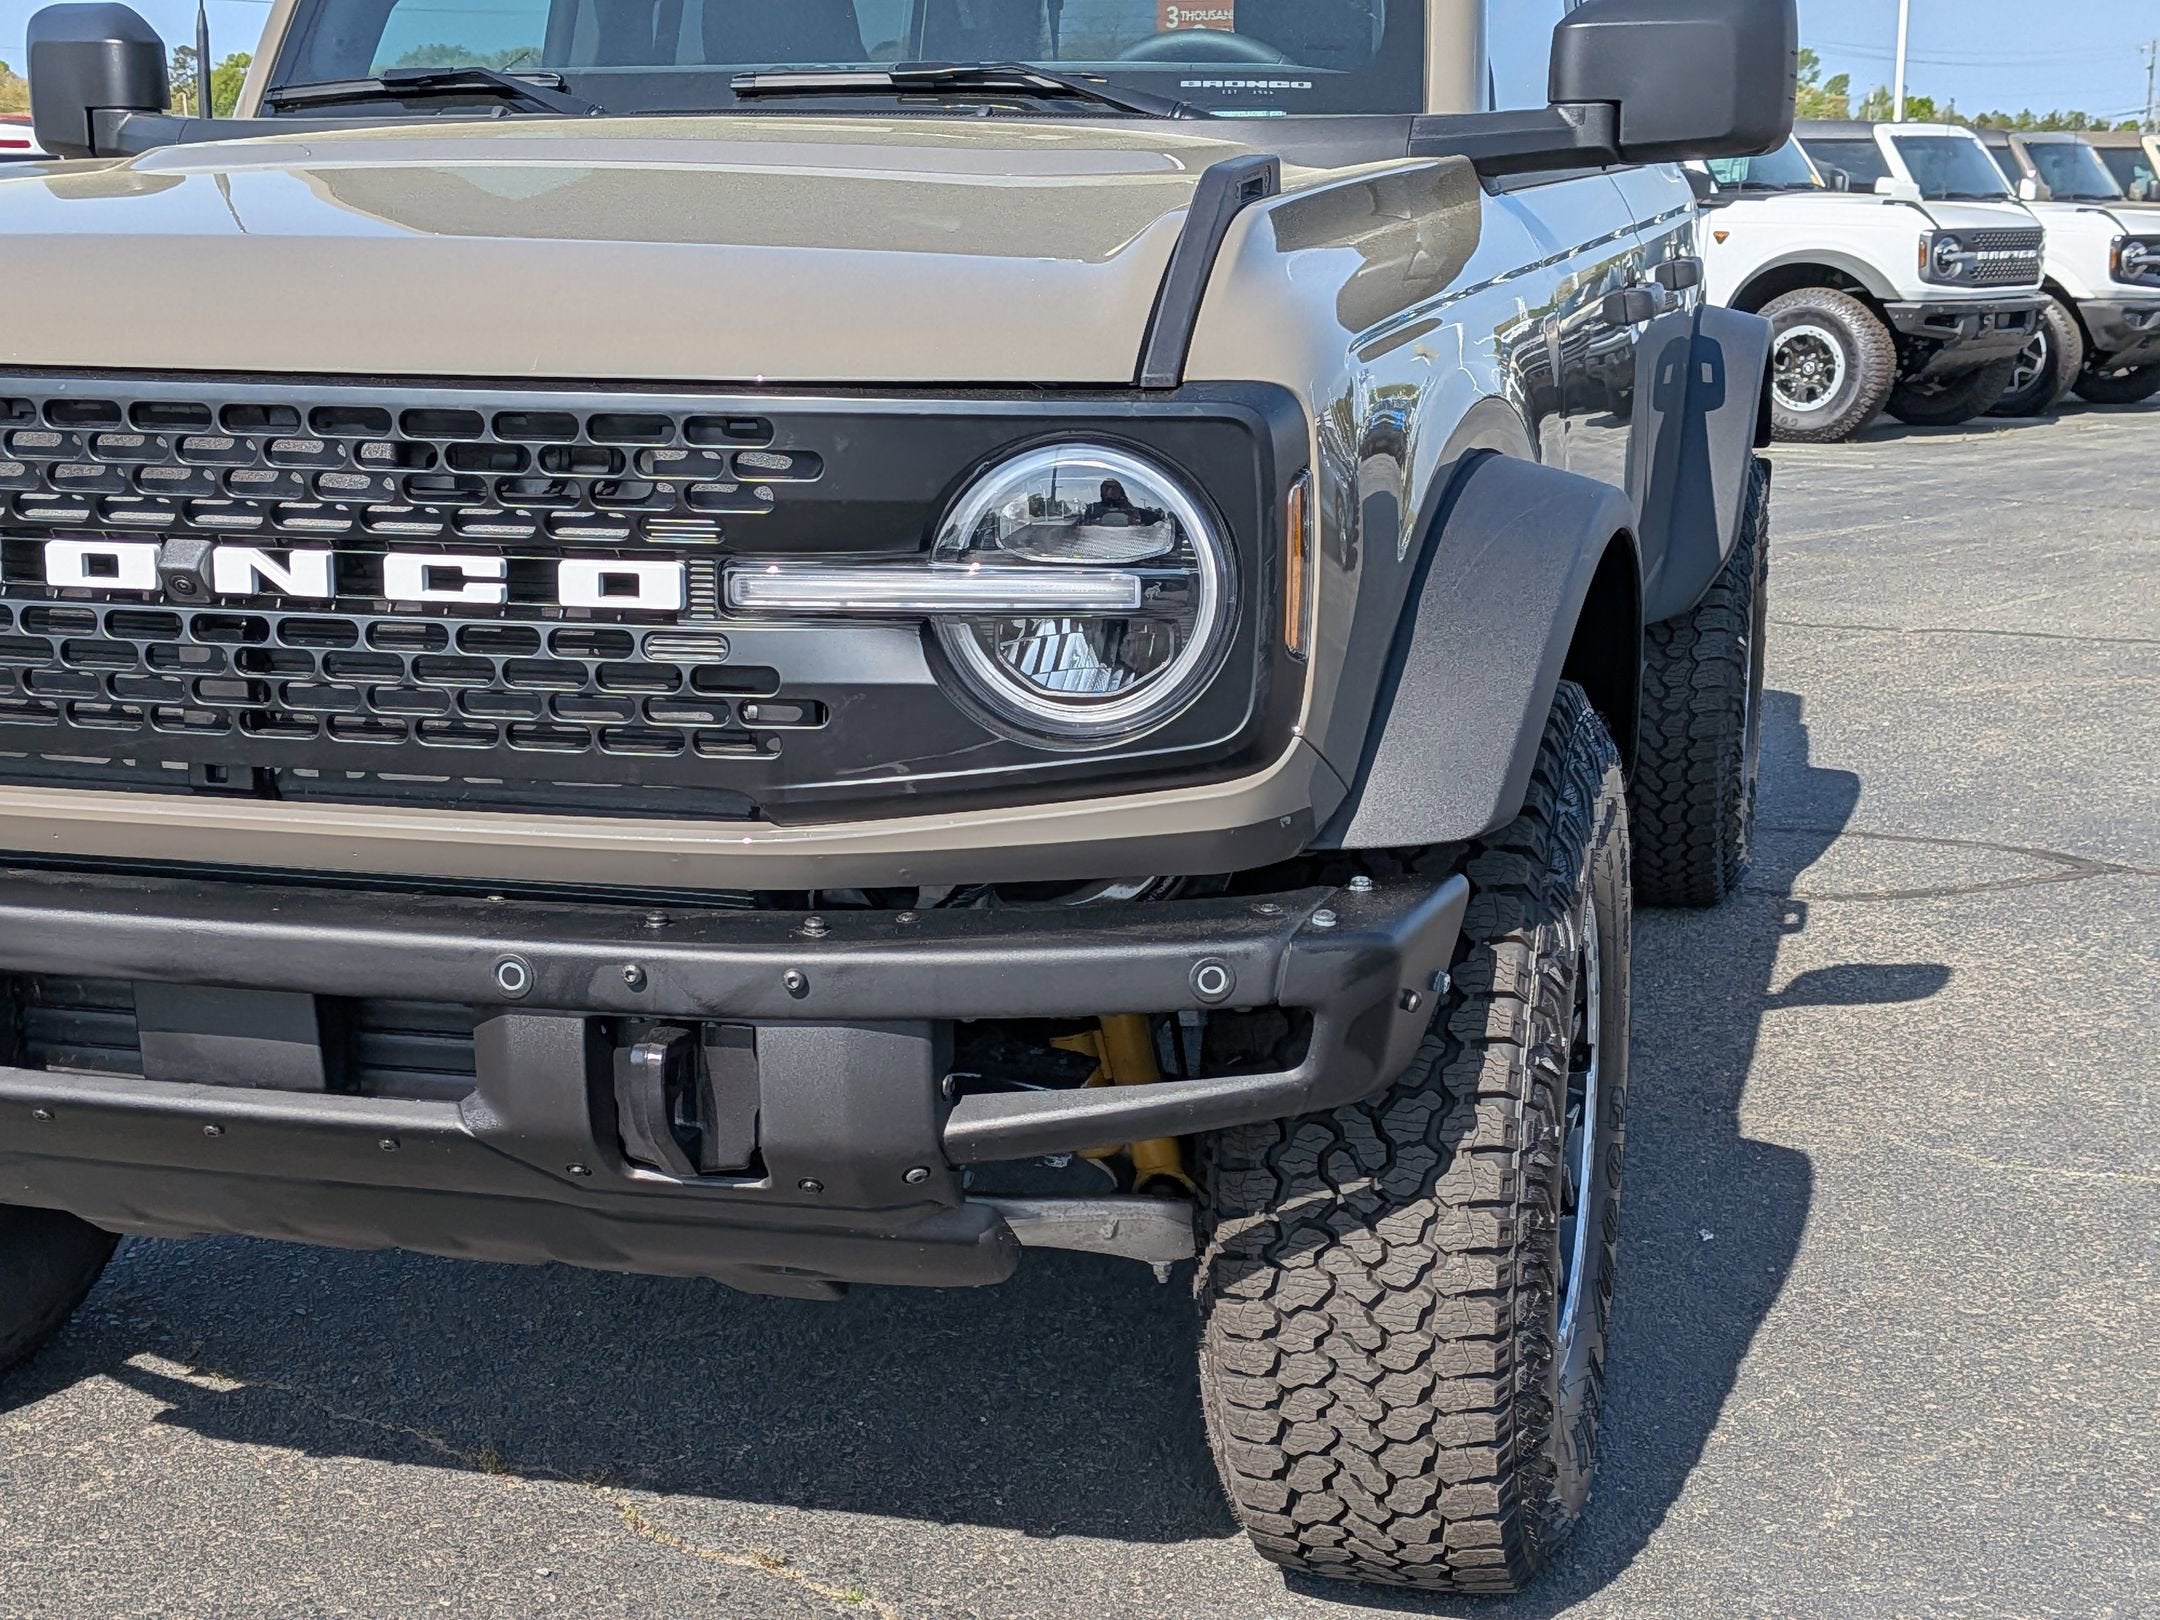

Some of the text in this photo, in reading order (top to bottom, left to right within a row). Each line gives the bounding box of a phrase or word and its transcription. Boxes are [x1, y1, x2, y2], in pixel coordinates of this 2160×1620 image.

[1166, 6, 1179, 28] 3
[1180, 9, 1234, 21] THOUSAN
[1180, 80, 1312, 88] BRONCO
[0, 540, 687, 611] ONCO
